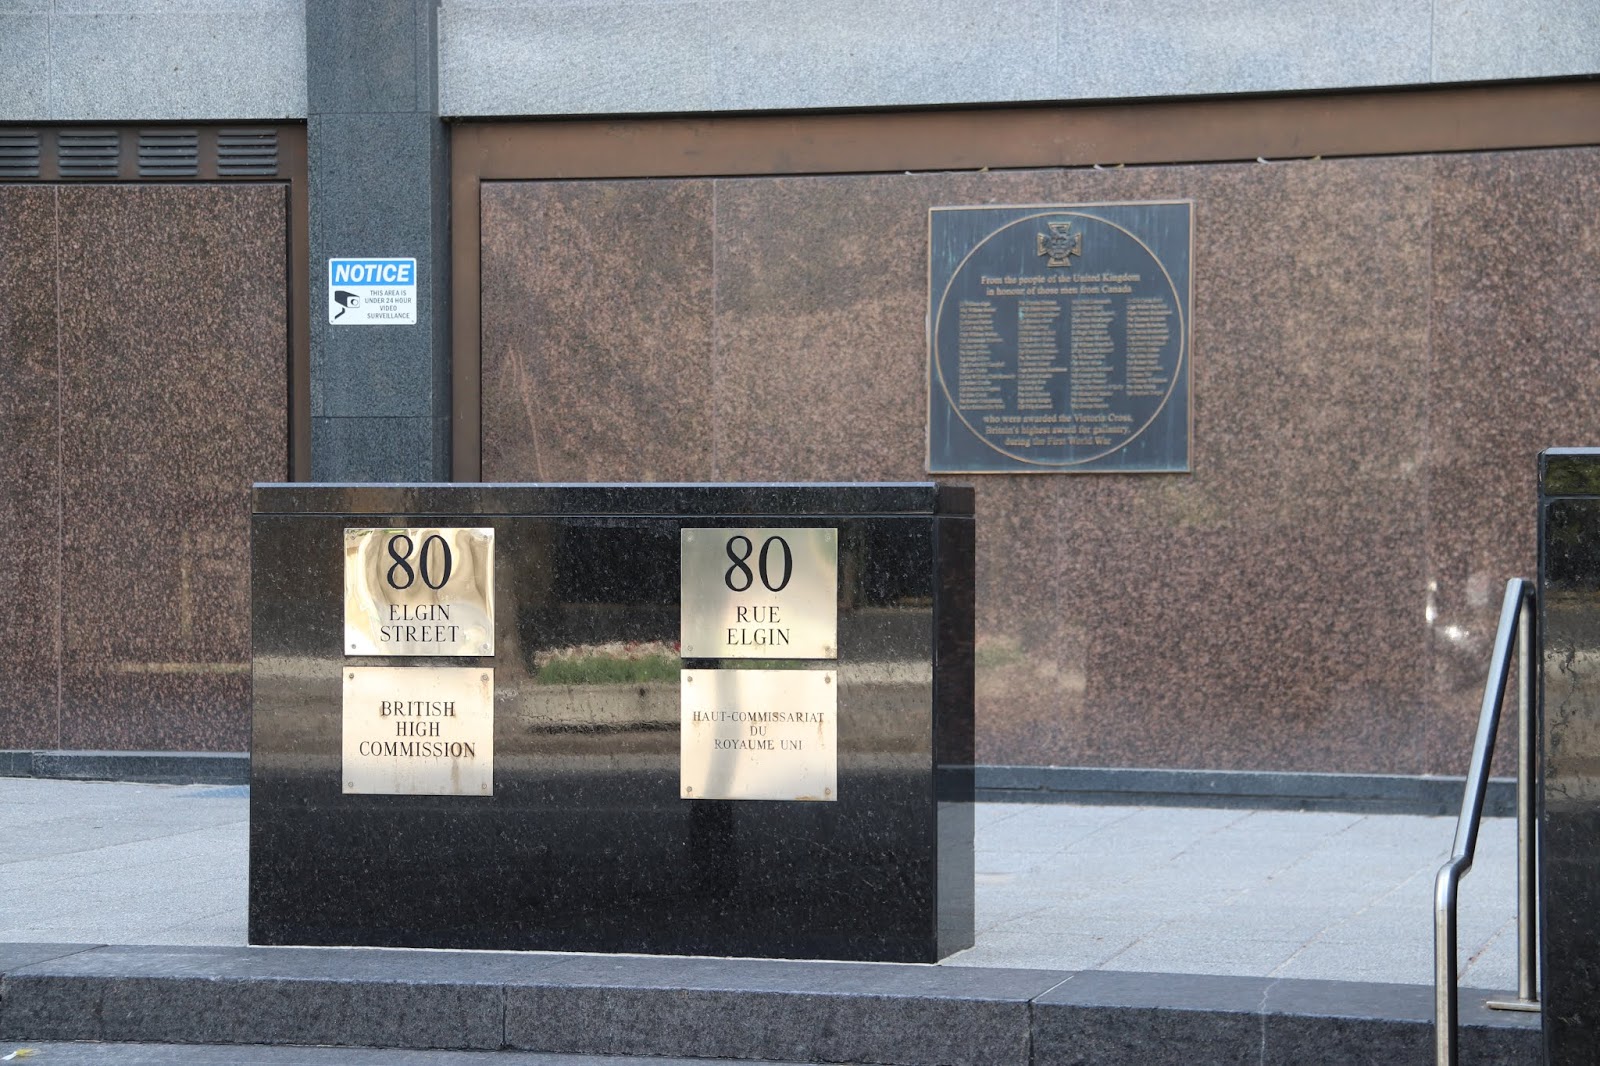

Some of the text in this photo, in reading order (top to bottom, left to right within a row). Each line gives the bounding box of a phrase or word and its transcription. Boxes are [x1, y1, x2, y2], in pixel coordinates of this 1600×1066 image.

[335, 264, 411, 283] NOTICE
[981, 273, 1141, 286] From the people of the United Kingdom
[986, 284, 1132, 296] in honour of those men from Canada
[983, 415, 1000, 423] who
[1002, 415, 1021, 423] were
[1023, 414, 1057, 423] awarded
[1058, 414, 1072, 423] the
[1074, 413, 1105, 422] Victoria
[985, 425, 1019, 435] Britain's
[386, 534, 452, 590] 80
[724, 535, 793, 592] 80
[389, 604, 450, 621] ELGIN
[736, 606, 781, 624] RUE
[380, 625, 460, 643] STREET
[726, 628, 790, 646] ELGIN
[380, 700, 456, 717] BRITISH
[692, 711, 825, 723] HAUT-COMMISSARIAT
[395, 721, 441, 737] HIGH
[750, 725, 767, 737] DU
[359, 740, 476, 758] COMMISSION
[714, 739, 803, 751] ROYAUME UNI
